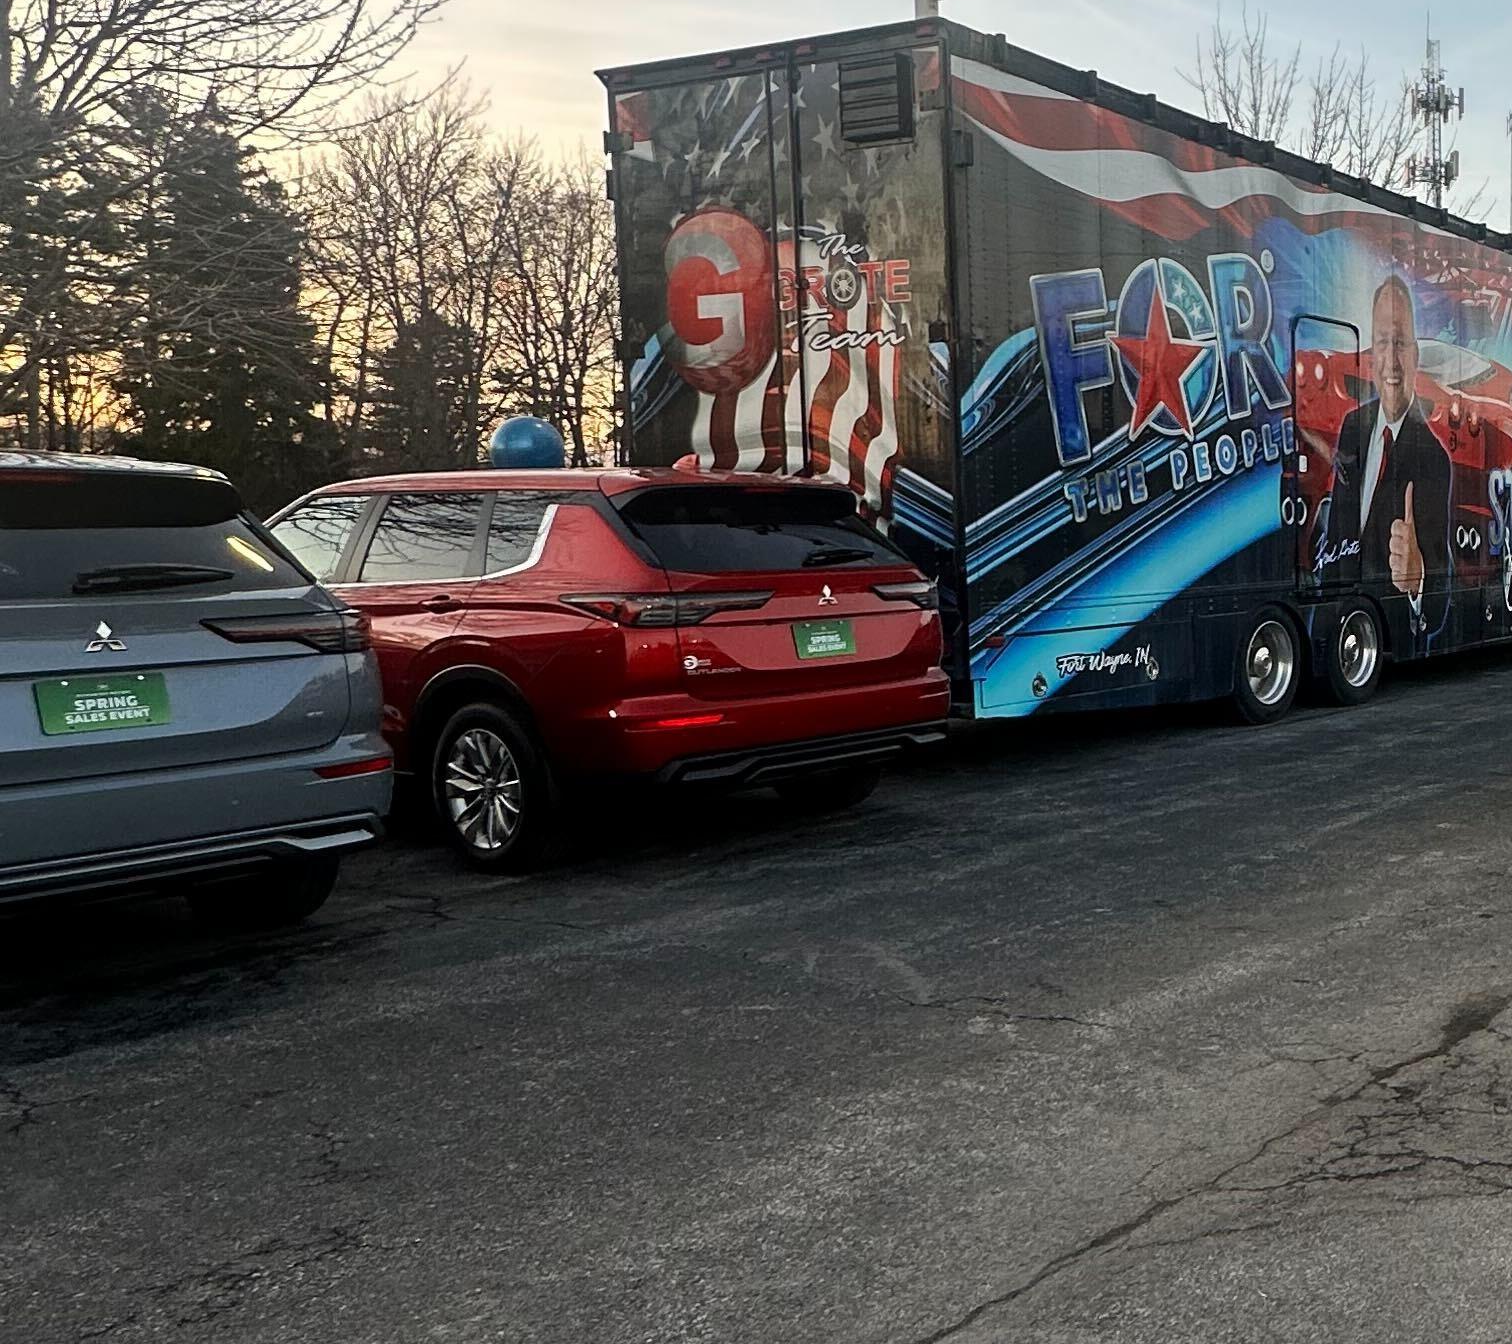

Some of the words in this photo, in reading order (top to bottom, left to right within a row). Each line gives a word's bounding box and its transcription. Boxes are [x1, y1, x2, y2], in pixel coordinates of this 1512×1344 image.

[818, 233, 866, 257] The
[785, 310, 906, 354] Team
[1064, 461, 1148, 522] THE
[1170, 417, 1299, 490] PEOPLE
[1058, 655, 1086, 676] Fort
[1135, 644, 1150, 667] IN
[65, 710, 107, 724] SALES
[109, 708, 150, 720] EVENT
[74, 695, 138, 711] SPRING
